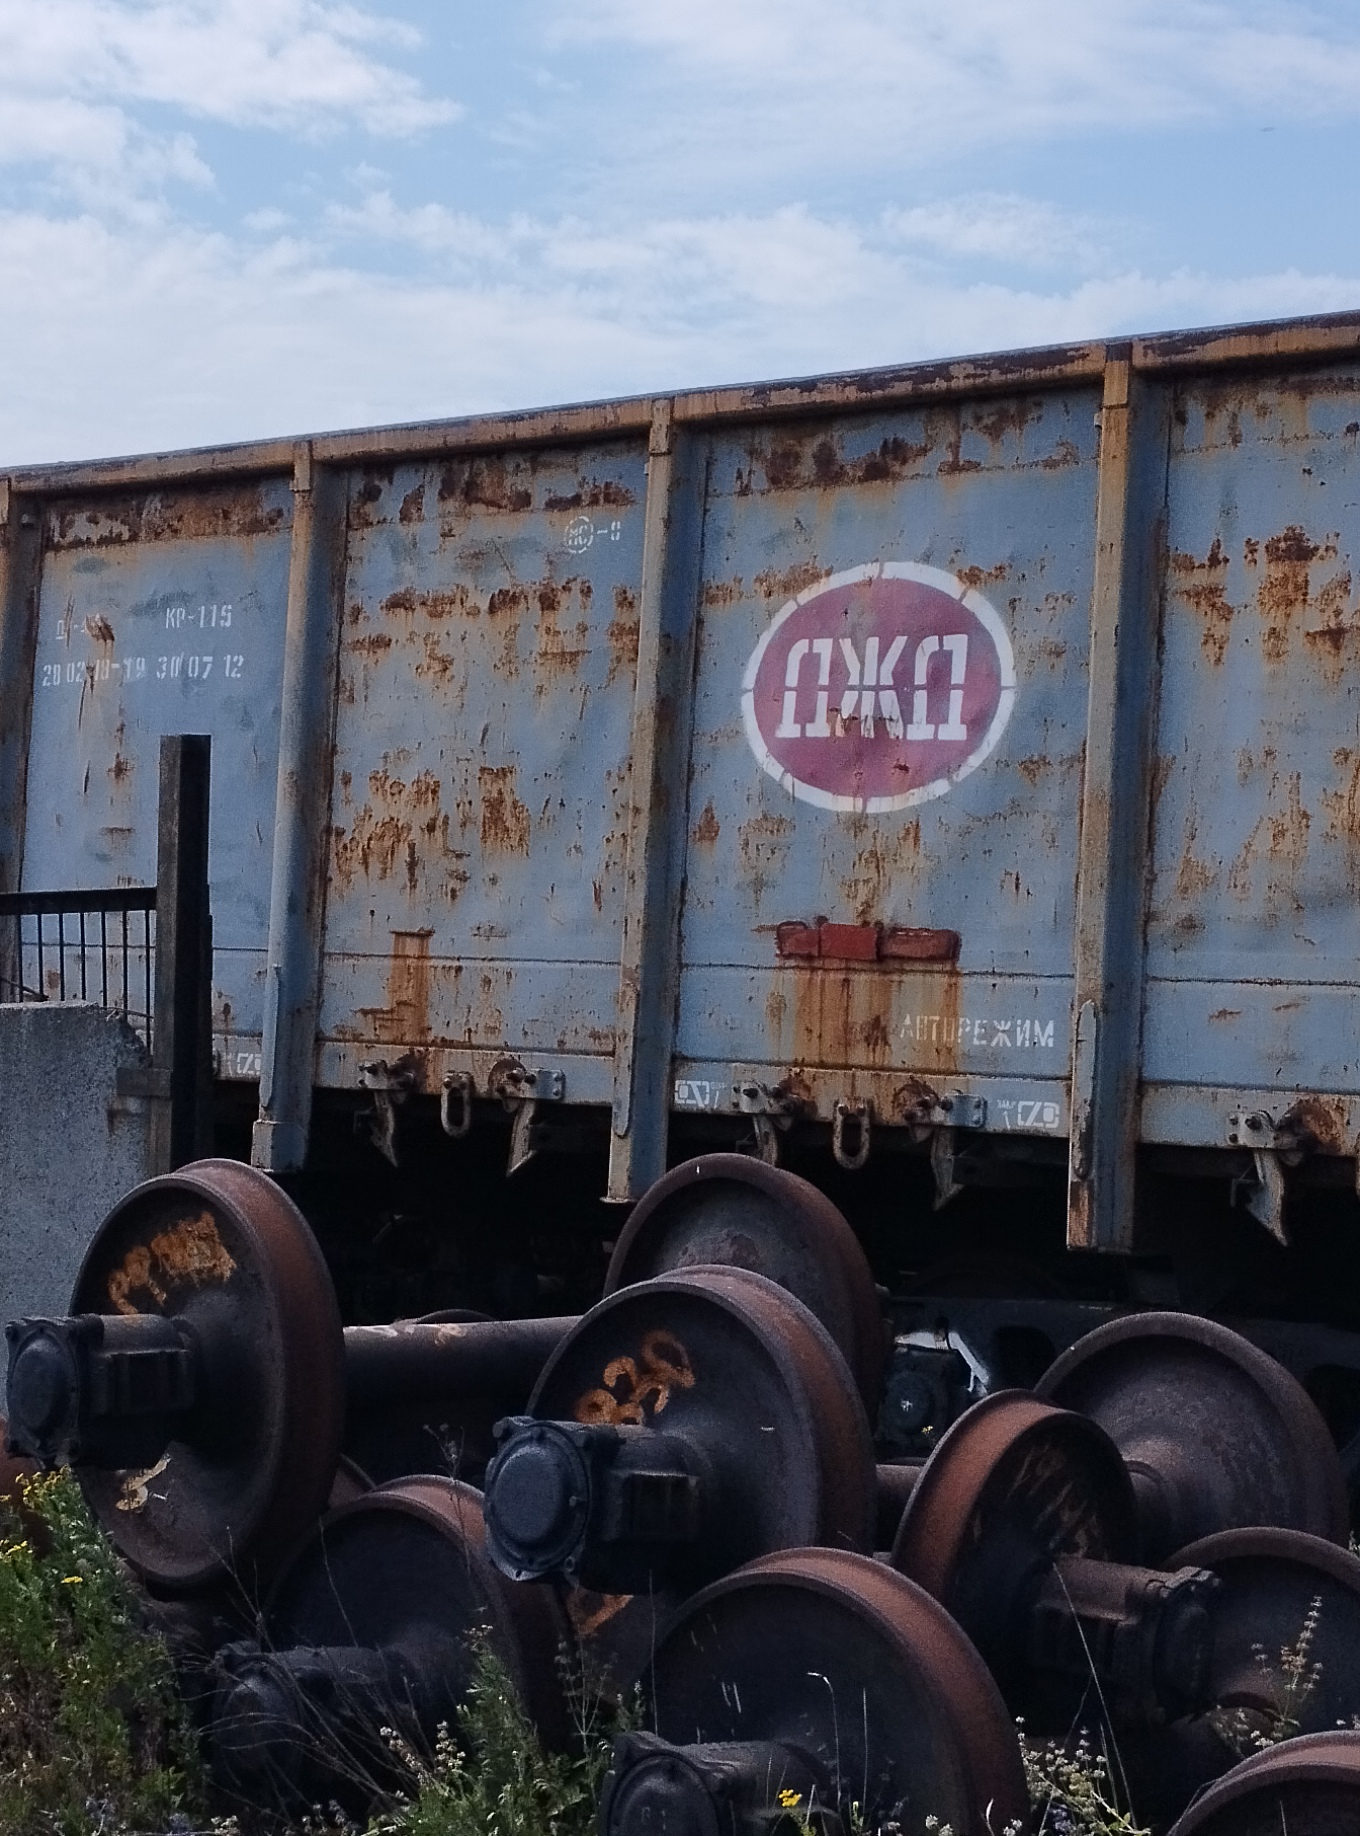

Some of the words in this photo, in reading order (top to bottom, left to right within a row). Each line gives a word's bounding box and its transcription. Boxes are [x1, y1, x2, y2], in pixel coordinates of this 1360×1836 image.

[188, 655, 214, 679] 07
[223, 654, 244, 678] 12
[900, 1013, 1055, 1048] АВТОРЕЖИМ
